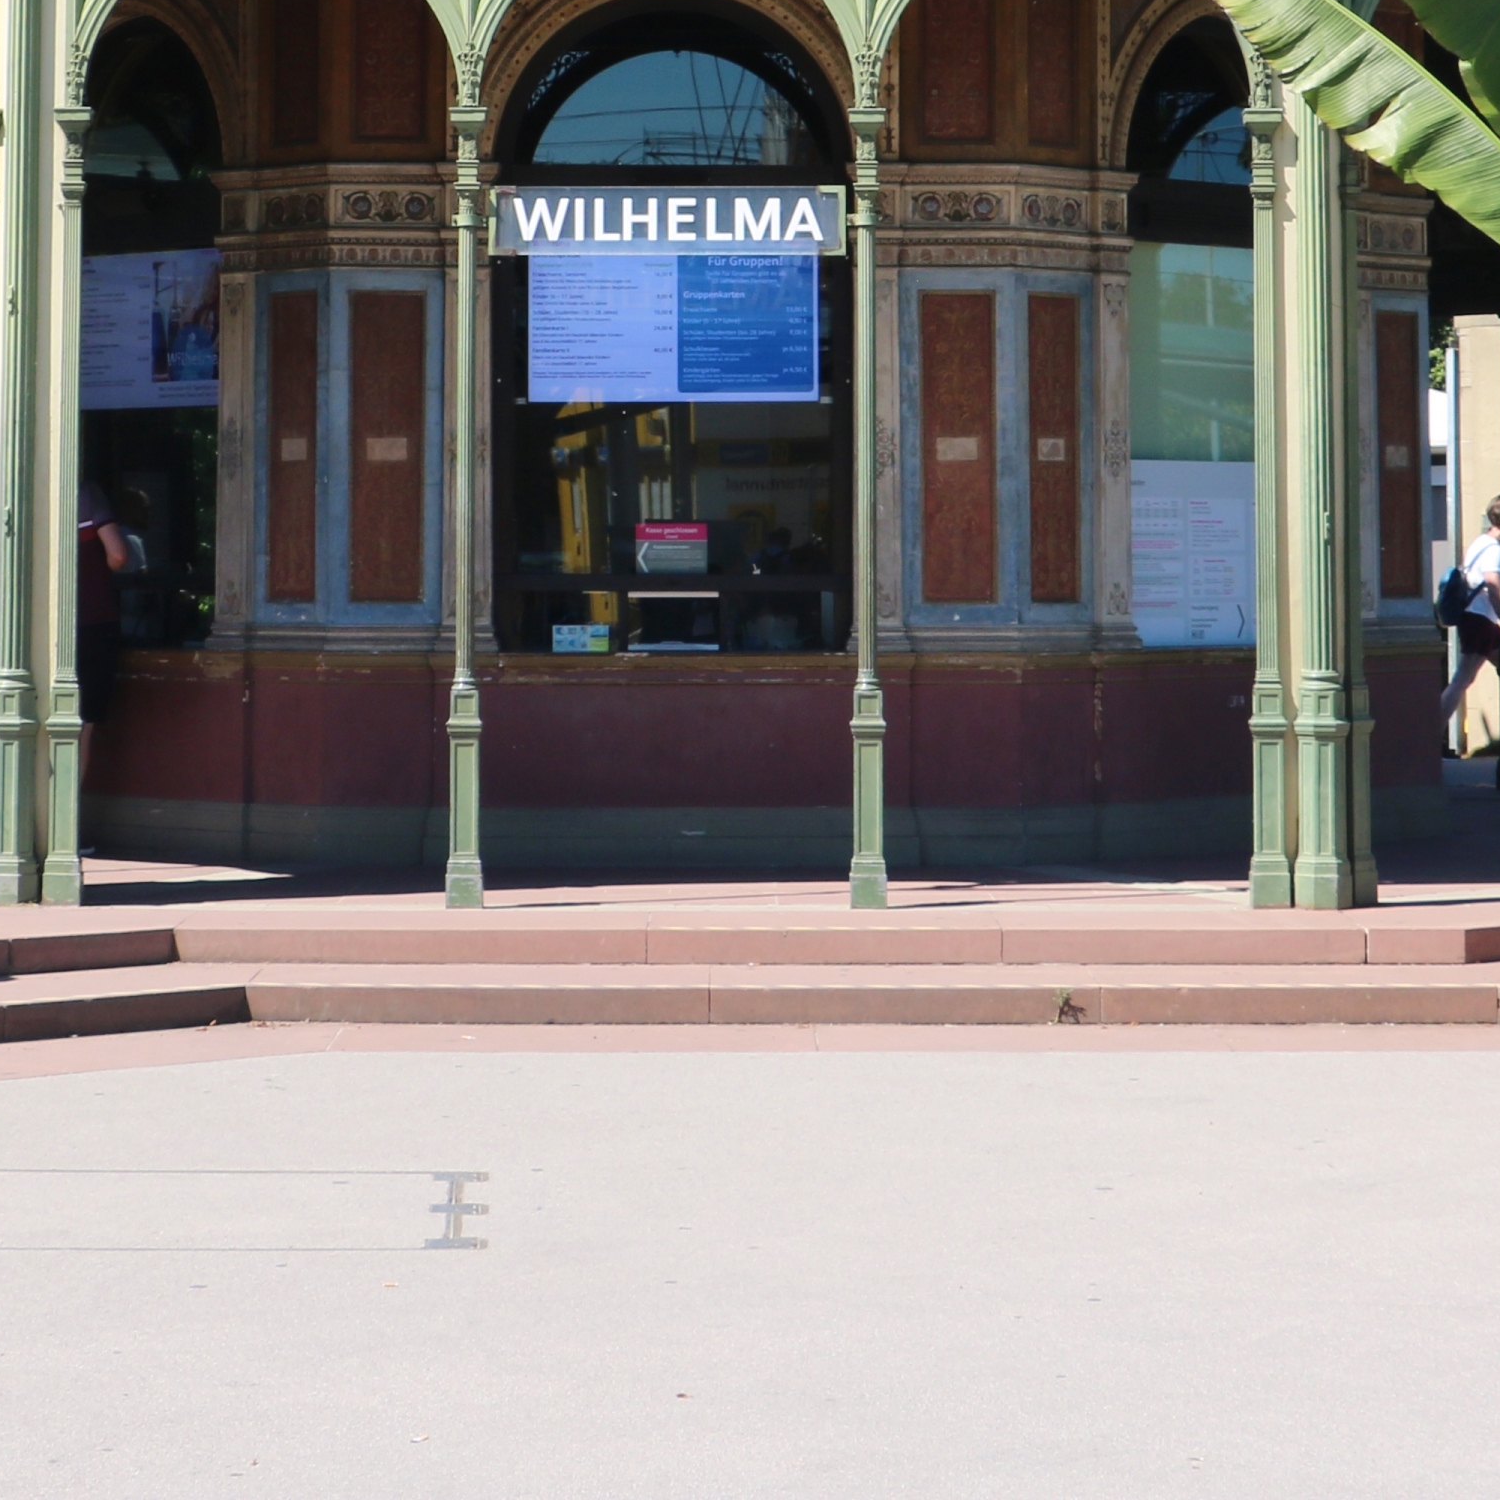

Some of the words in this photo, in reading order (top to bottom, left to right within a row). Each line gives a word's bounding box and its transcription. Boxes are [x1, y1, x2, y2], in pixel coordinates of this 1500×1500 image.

[513, 197, 824, 241] WILHELMA
[707, 255, 726, 266] Für
[729, 255, 783, 269] Gruppen!
[683, 290, 745, 300] Gruppenkarten
